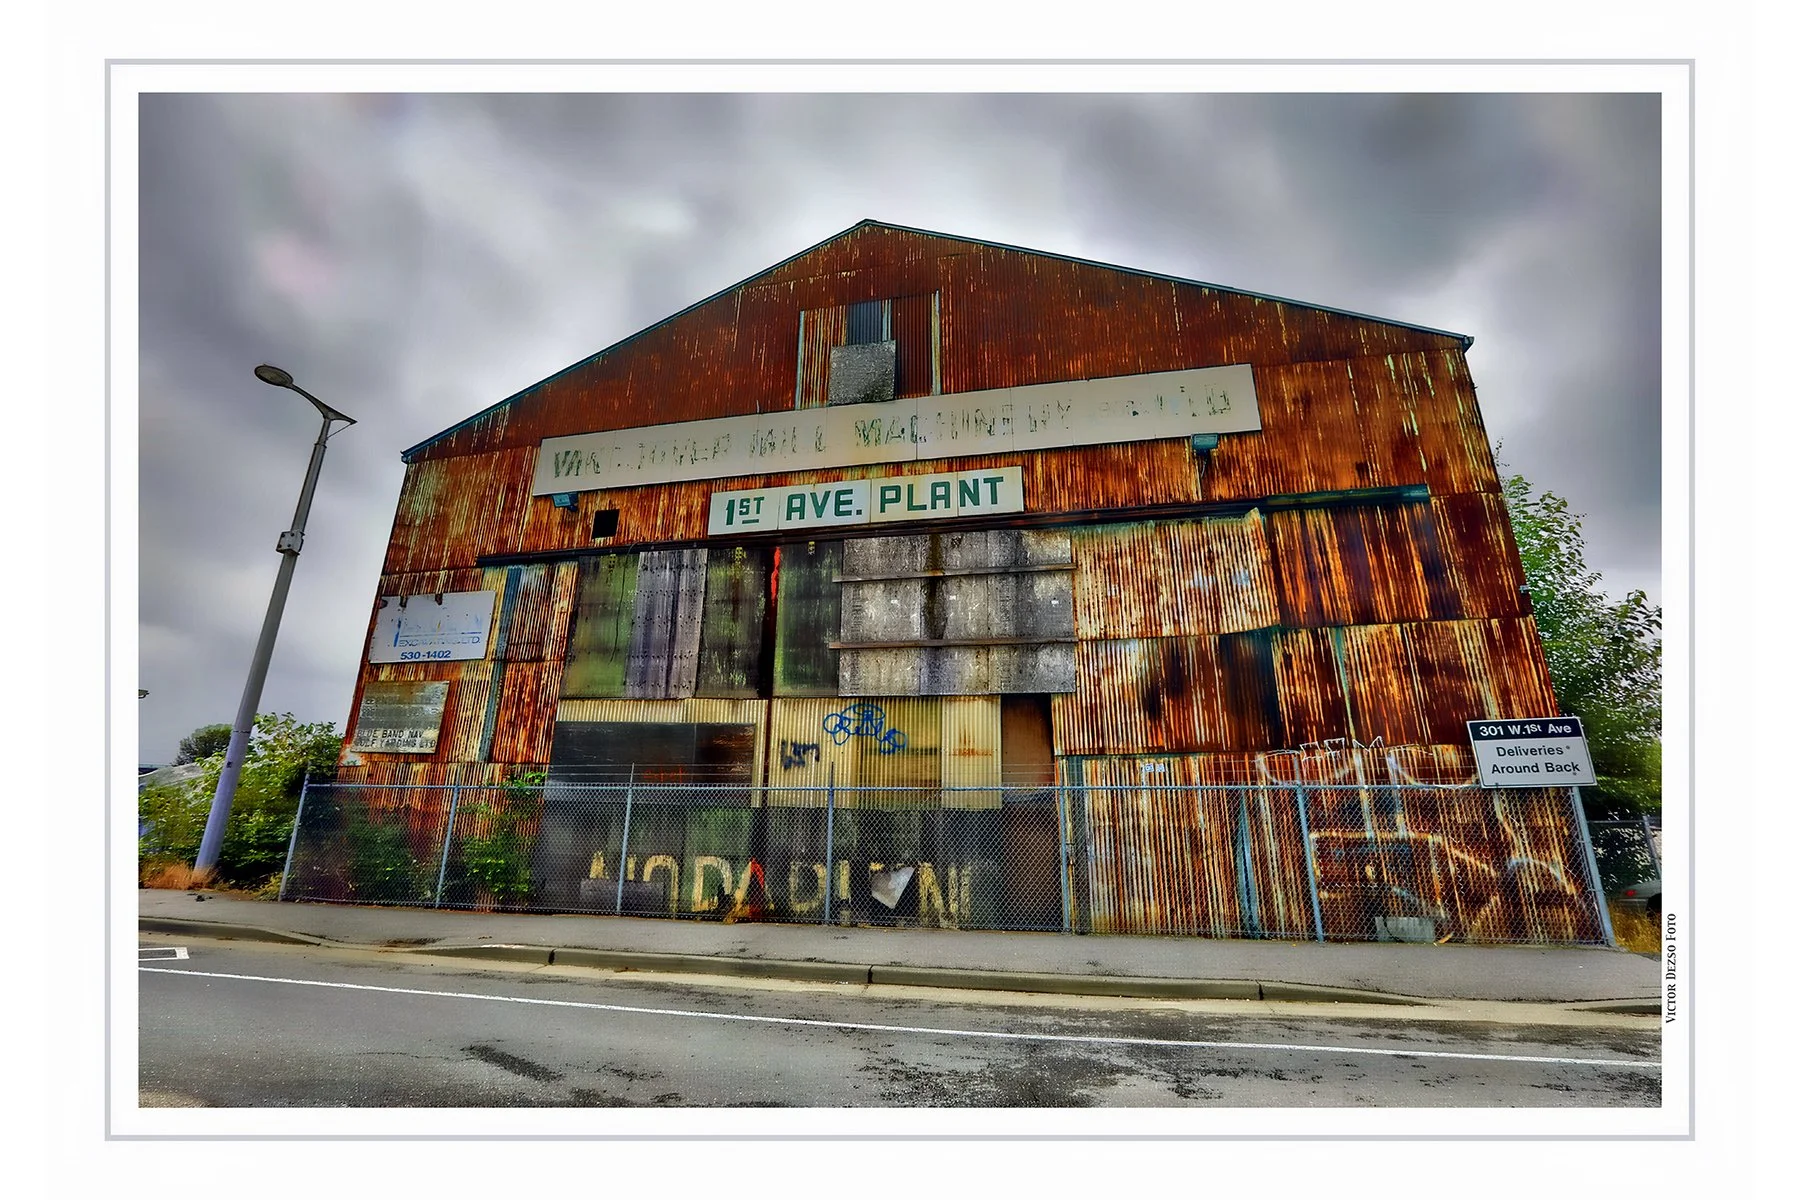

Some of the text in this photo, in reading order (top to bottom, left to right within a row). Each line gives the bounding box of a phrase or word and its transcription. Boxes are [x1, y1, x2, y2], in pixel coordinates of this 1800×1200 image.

[725, 476, 1004, 526] 1ST AVE. PLANT
[400, 649, 452, 660] 530-1402
[381, 729, 404, 738] BAND
[1479, 725, 1504, 737] 301
[1547, 723, 1572, 734] Ave
[1496, 745, 1564, 757] Deliveries
[1491, 762, 1581, 774] Around Back
